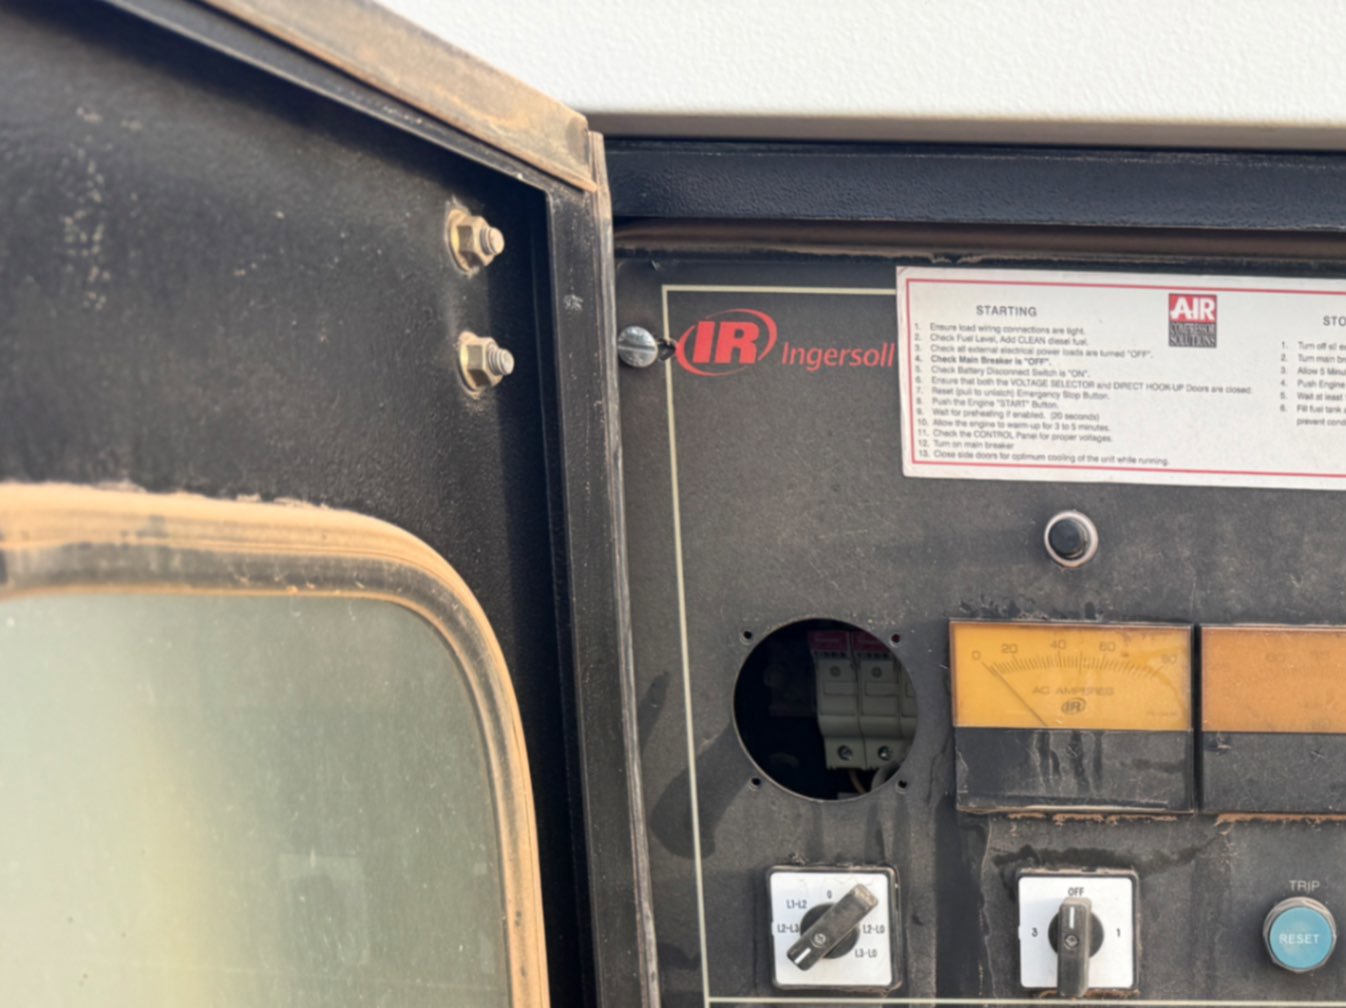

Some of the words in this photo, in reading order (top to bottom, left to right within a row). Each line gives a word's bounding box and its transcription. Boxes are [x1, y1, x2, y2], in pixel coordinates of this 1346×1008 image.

[976, 305, 1036, 316] STARTING
[1171, 296, 1216, 320] AIR
[692, 320, 760, 364] IR
[781, 341, 896, 372] Ingersoll
[930, 354, 956, 363] Check
[958, 355, 978, 363] Main
[980, 356, 1012, 364] Breaker
[1014, 357, 1022, 365] is
[1001, 643, 1018, 654] 20
[1050, 639, 1066, 650] 40
[971, 651, 981, 660] 0
[1289, 880, 1320, 892] TRIP
[1068, 887, 1085, 897] OFF
[786, 899, 807, 909] L1-L2
[777, 924, 800, 933] L2-L3
[1032, 927, 1038, 937] 3
[1117, 928, 1121, 937] 1
[1279, 934, 1320, 945] RESET
